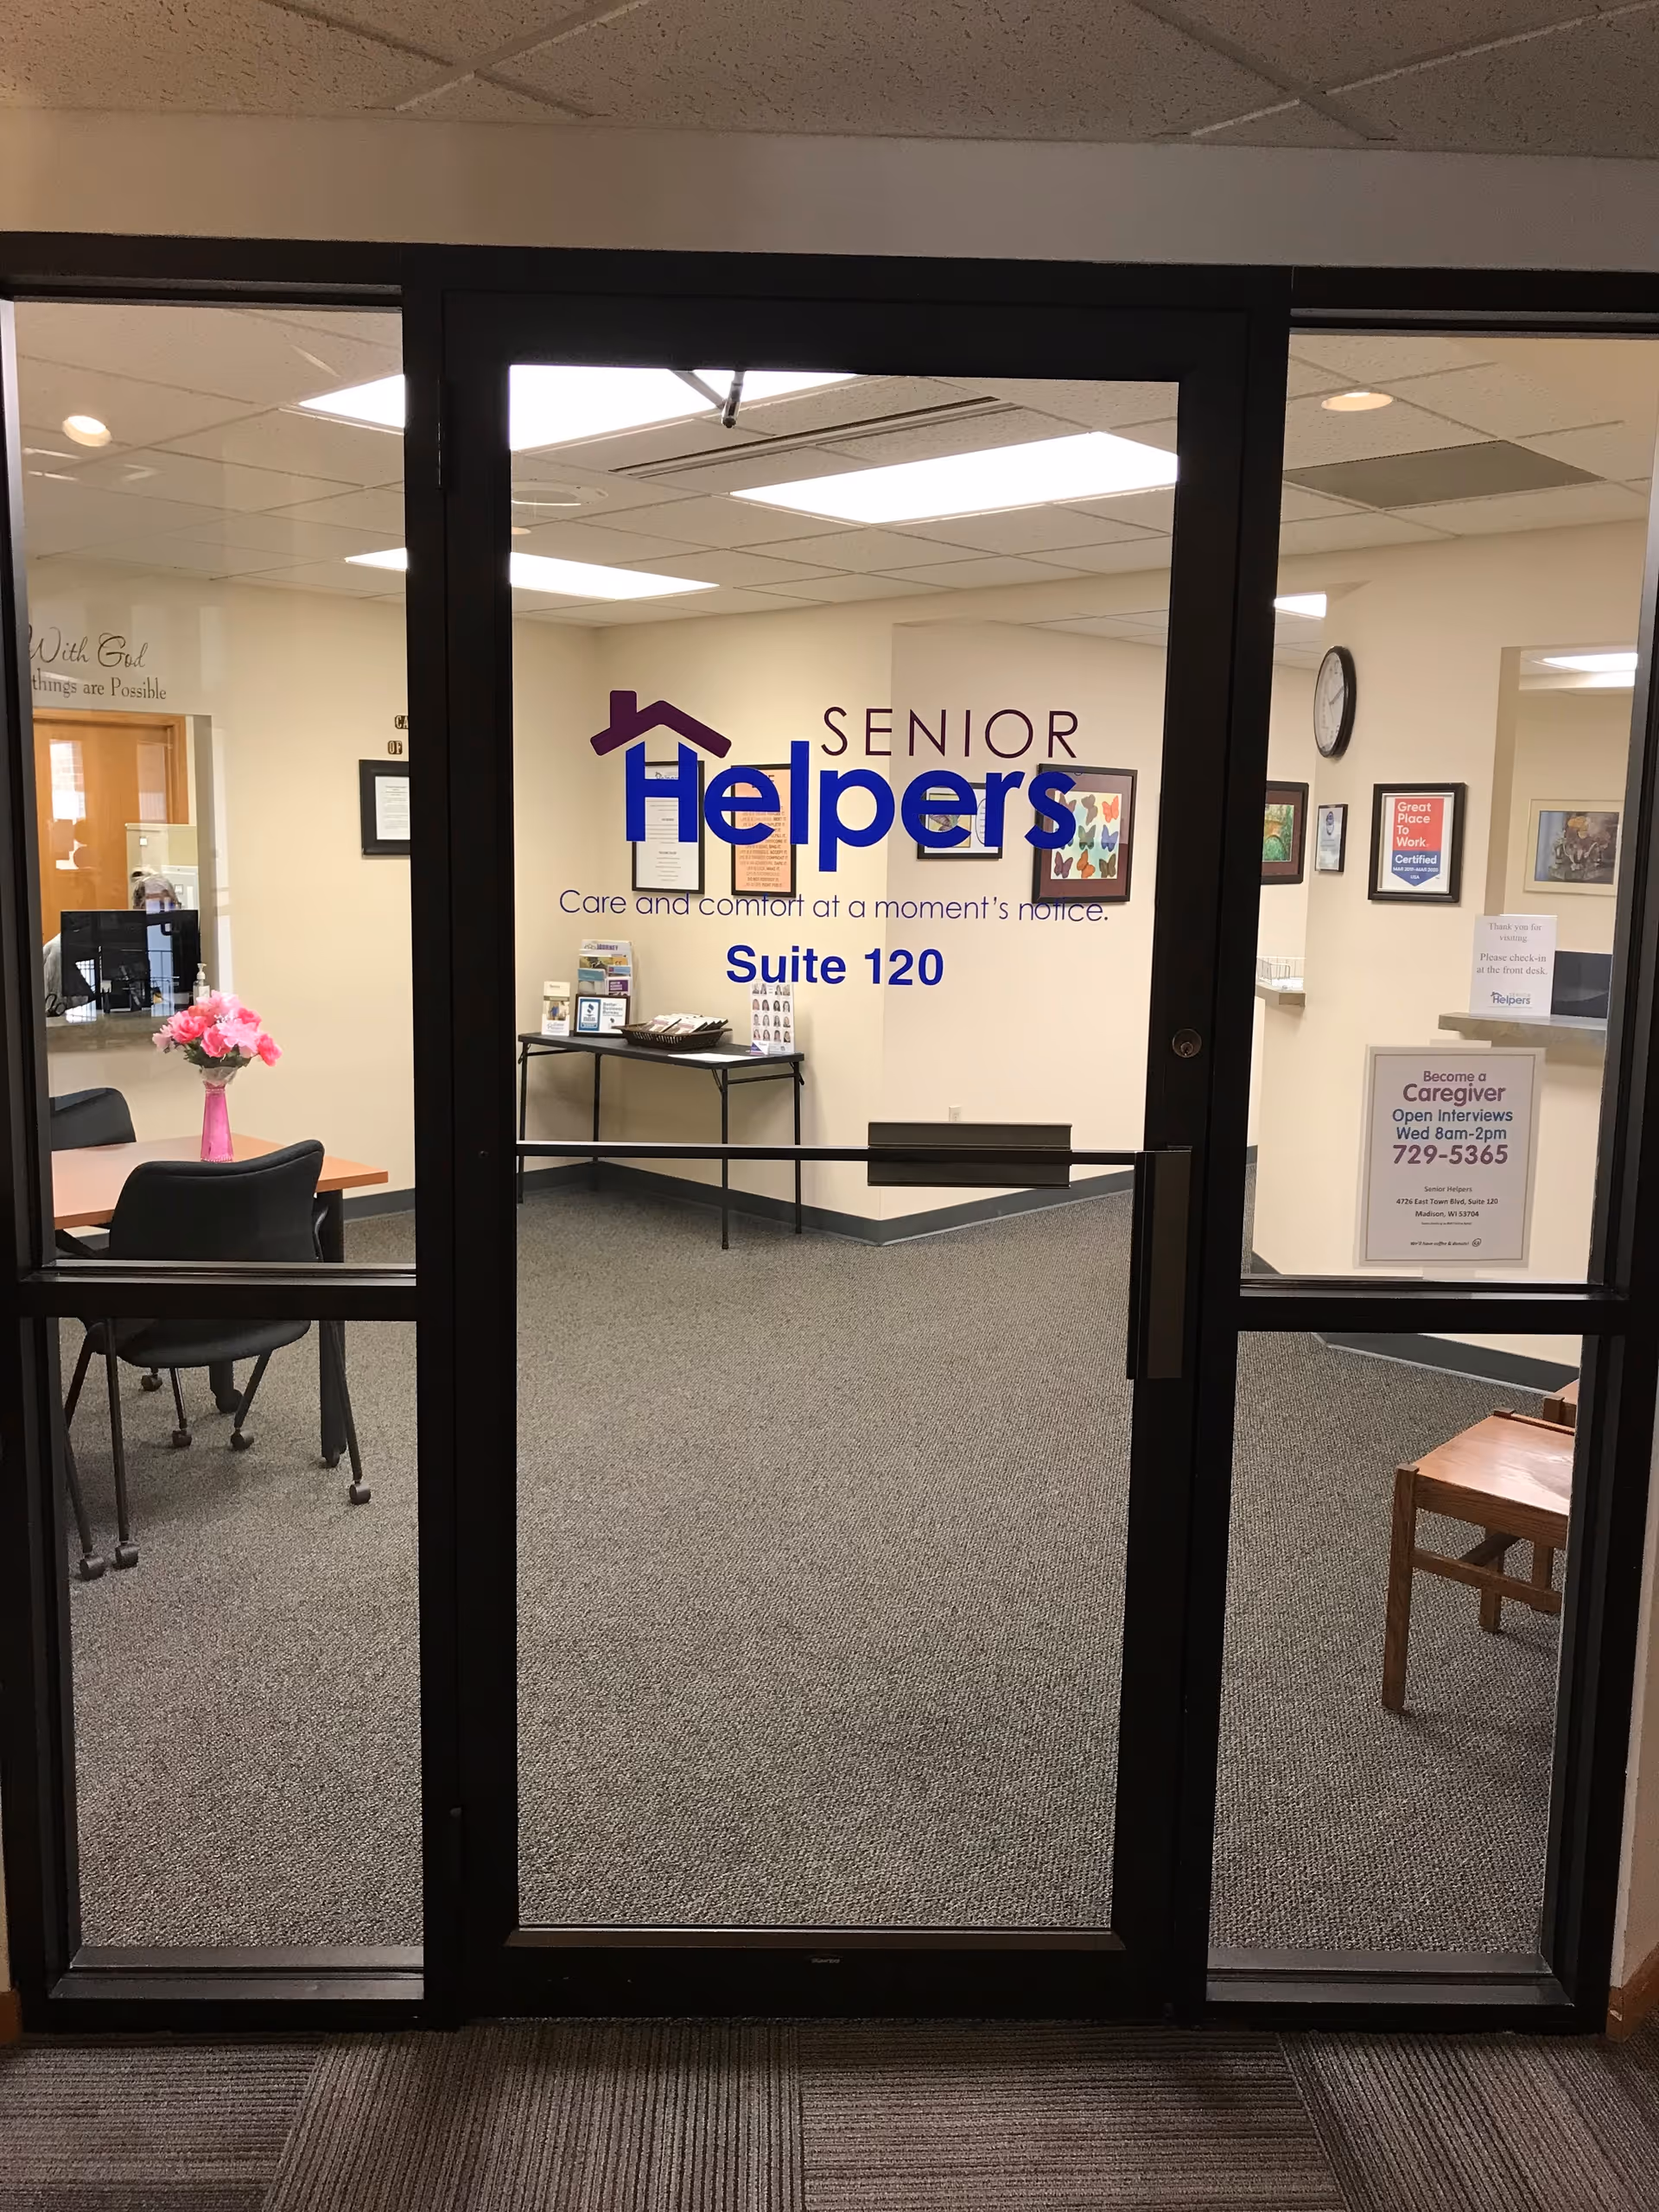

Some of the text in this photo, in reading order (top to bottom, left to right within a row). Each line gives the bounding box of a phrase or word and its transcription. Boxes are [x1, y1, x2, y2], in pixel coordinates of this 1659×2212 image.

[29, 622, 149, 669] With God
[32, 668, 167, 700] things are Possible
[820, 706, 1078, 760] SENIOR
[387, 740, 403, 755] OF
[625, 741, 1077, 872] Helpers
[1397, 801, 1432, 812] Great
[1397, 813, 1431, 823] Place
[1396, 824, 1409, 836] To
[1395, 854, 1438, 865] Certified
[558, 889, 1110, 923] Care and comfort at a moment's notice.
[1489, 922, 1512, 931] Thank
[1531, 923, 1542, 931] for
[1479, 952, 1547, 963] Please check-in
[727, 945, 944, 986] Suite 120
[1486, 964, 1501, 974] the
[1503, 965, 1523, 975] front
[1526, 966, 1548, 976] desk.
[1492, 995, 1531, 1006] Helpers
[1423, 1071, 1487, 1082] Become a
[1402, 1084, 1507, 1107] Caregiver
[1391, 1109, 1514, 1125] Open Interviews
[1395, 1126, 1507, 1143] Wed 8am-2pm
[1392, 1144, 1509, 1165] 729-5365
[1450, 1198, 1467, 1206] Blvd,
[1414, 1210, 1446, 1218] Madison,
